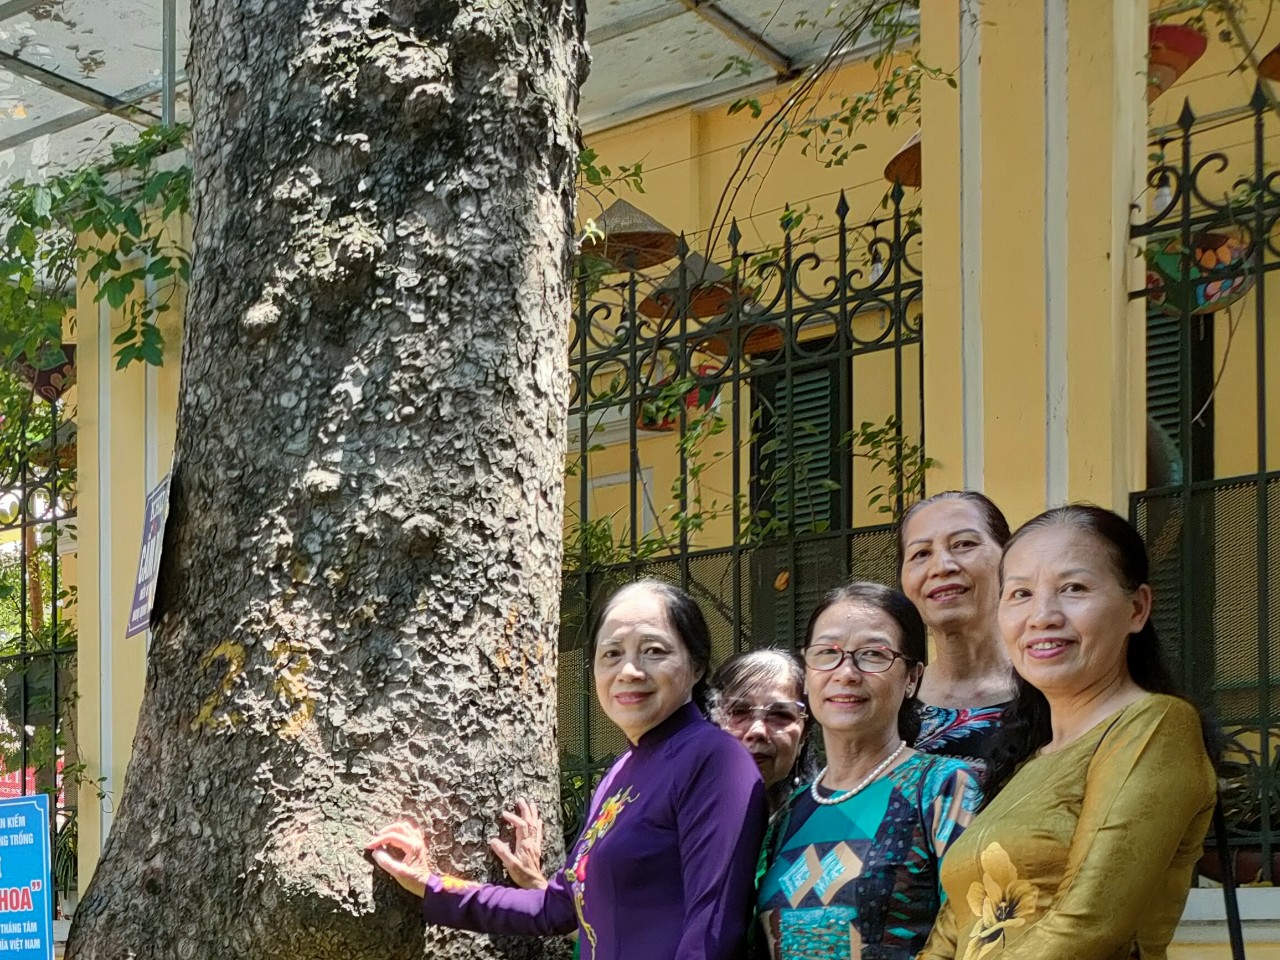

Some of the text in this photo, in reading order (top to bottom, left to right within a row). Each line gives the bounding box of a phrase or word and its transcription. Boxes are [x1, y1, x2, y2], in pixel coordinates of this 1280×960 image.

[7, 812, 26, 828] KIẾM
[10, 830, 34, 846] TRỐNG
[0, 920, 21, 934] THÁNG
[22, 920, 37, 933] TÁM
[9, 937, 23, 952] VIỆT
[24, 938, 41, 950] NAM
